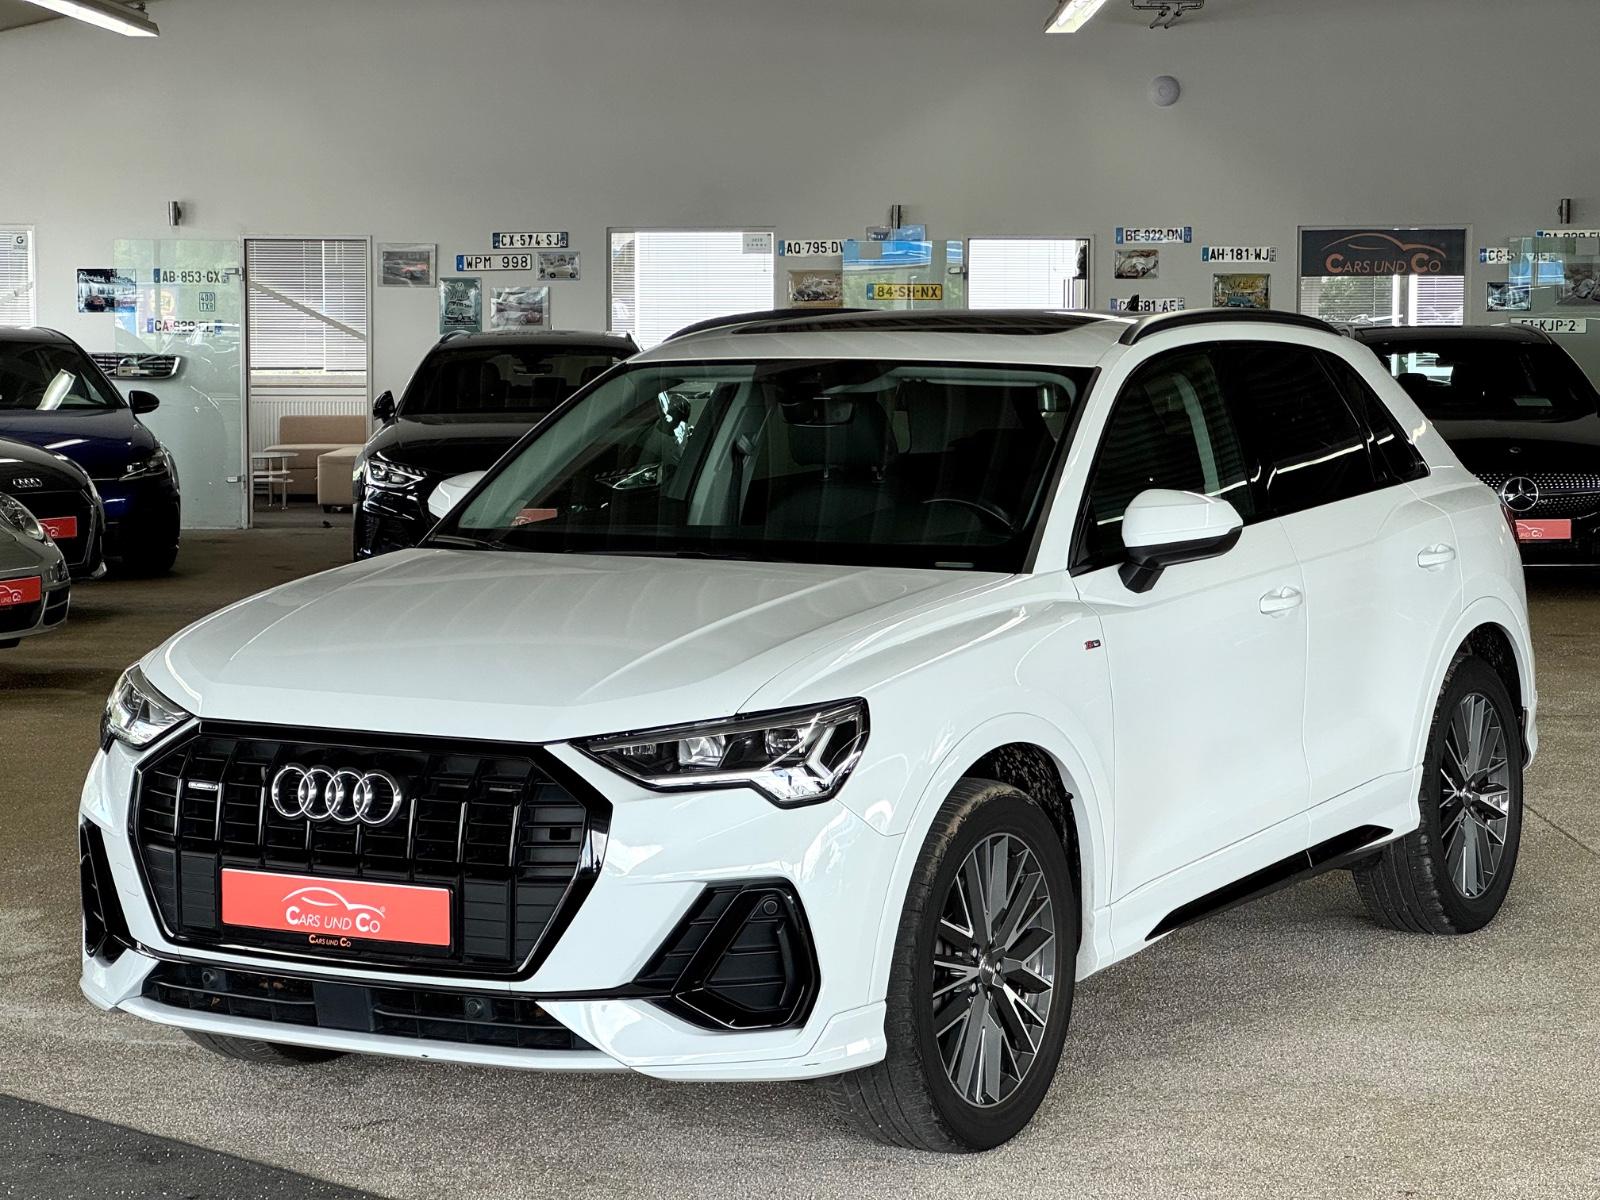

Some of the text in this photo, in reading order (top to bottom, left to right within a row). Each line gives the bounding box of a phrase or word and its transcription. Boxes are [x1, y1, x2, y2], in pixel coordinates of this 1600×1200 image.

[1125, 229, 1183, 241] BE-922-DN
[1209, 248, 1270, 261] AH-181-WJ
[465, 256, 528, 269] WPM 998
[162, 270, 221, 283] AB-853-GX
[324, 915, 352, 930] UND
